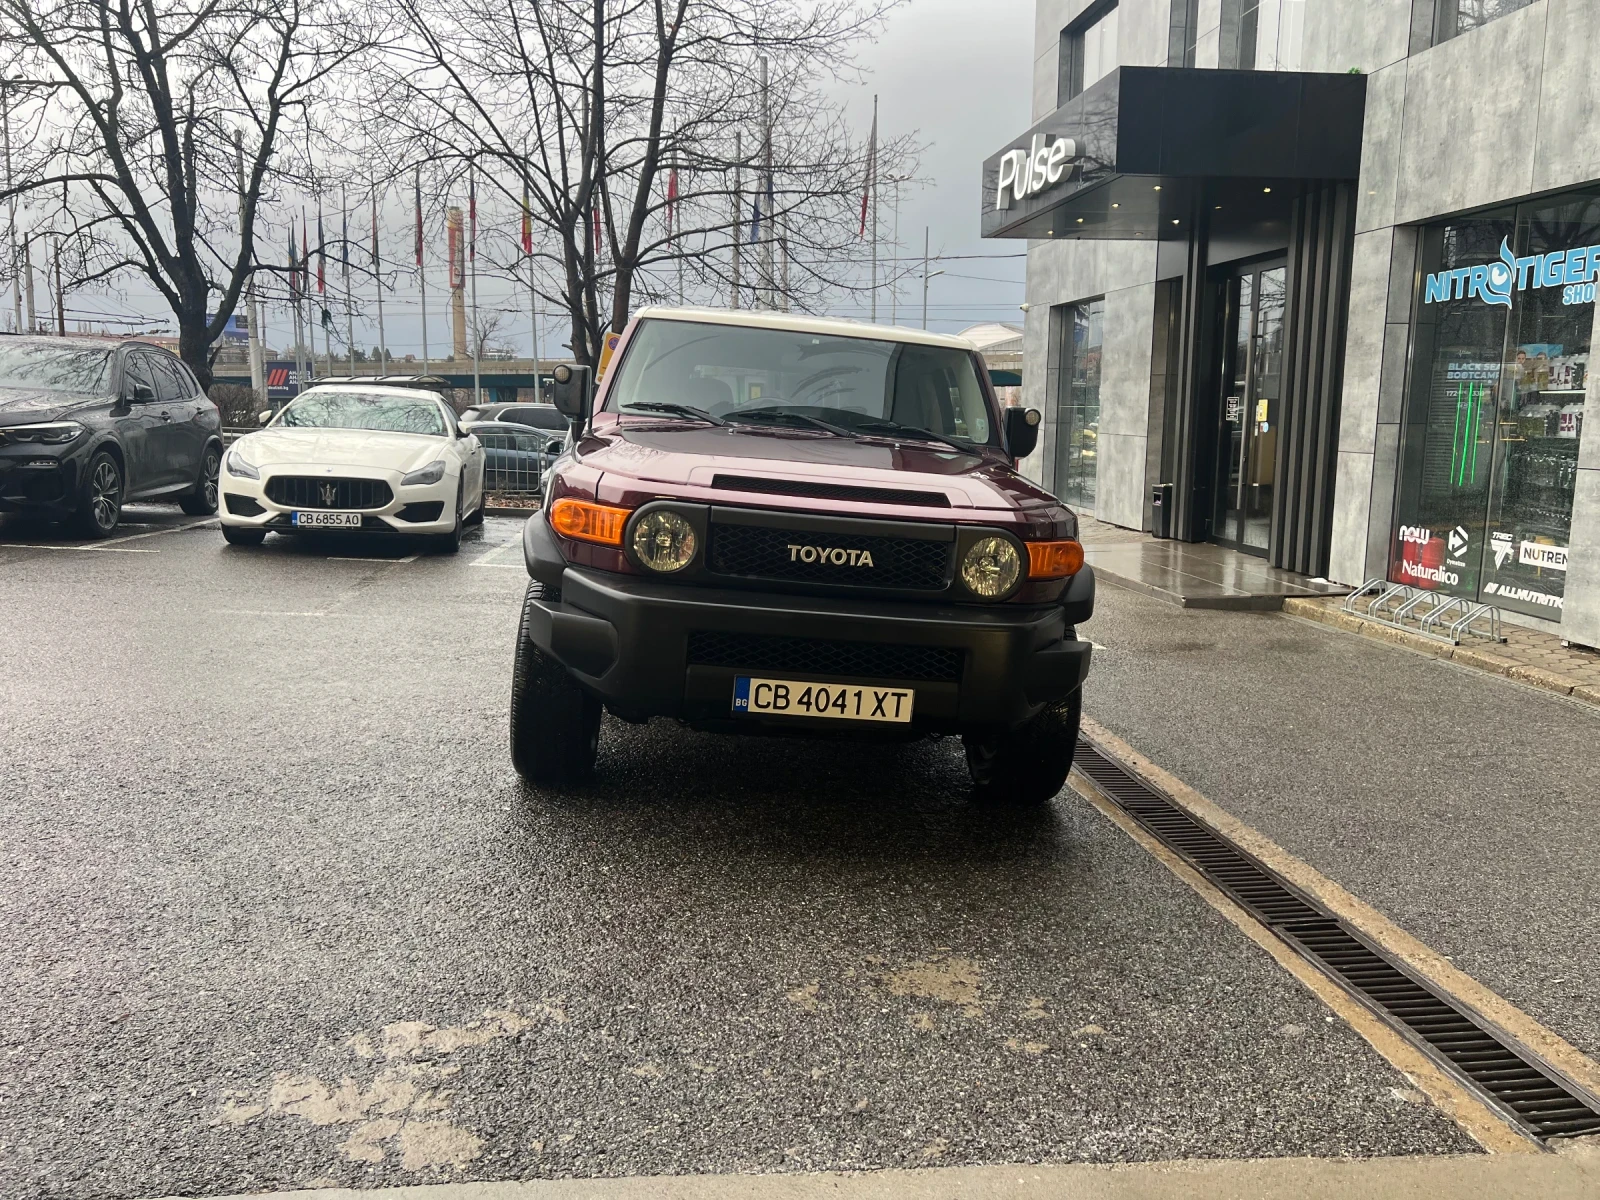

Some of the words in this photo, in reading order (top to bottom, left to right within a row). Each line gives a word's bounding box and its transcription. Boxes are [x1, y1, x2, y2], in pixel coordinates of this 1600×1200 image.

[996, 133, 1075, 210] Pulse
[1448, 363, 1480, 371] BLACK
[299, 513, 313, 525] CB
[315, 514, 342, 525] 6855
[345, 515, 359, 525] AO
[1492, 531, 1513, 541] TREC
[787, 544, 874, 567] TOYOTA
[1402, 559, 1459, 586] Naturalico
[735, 698, 748, 707] BG
[754, 683, 790, 710] CB
[797, 687, 863, 715] 4041
[870, 691, 908, 717] XT
